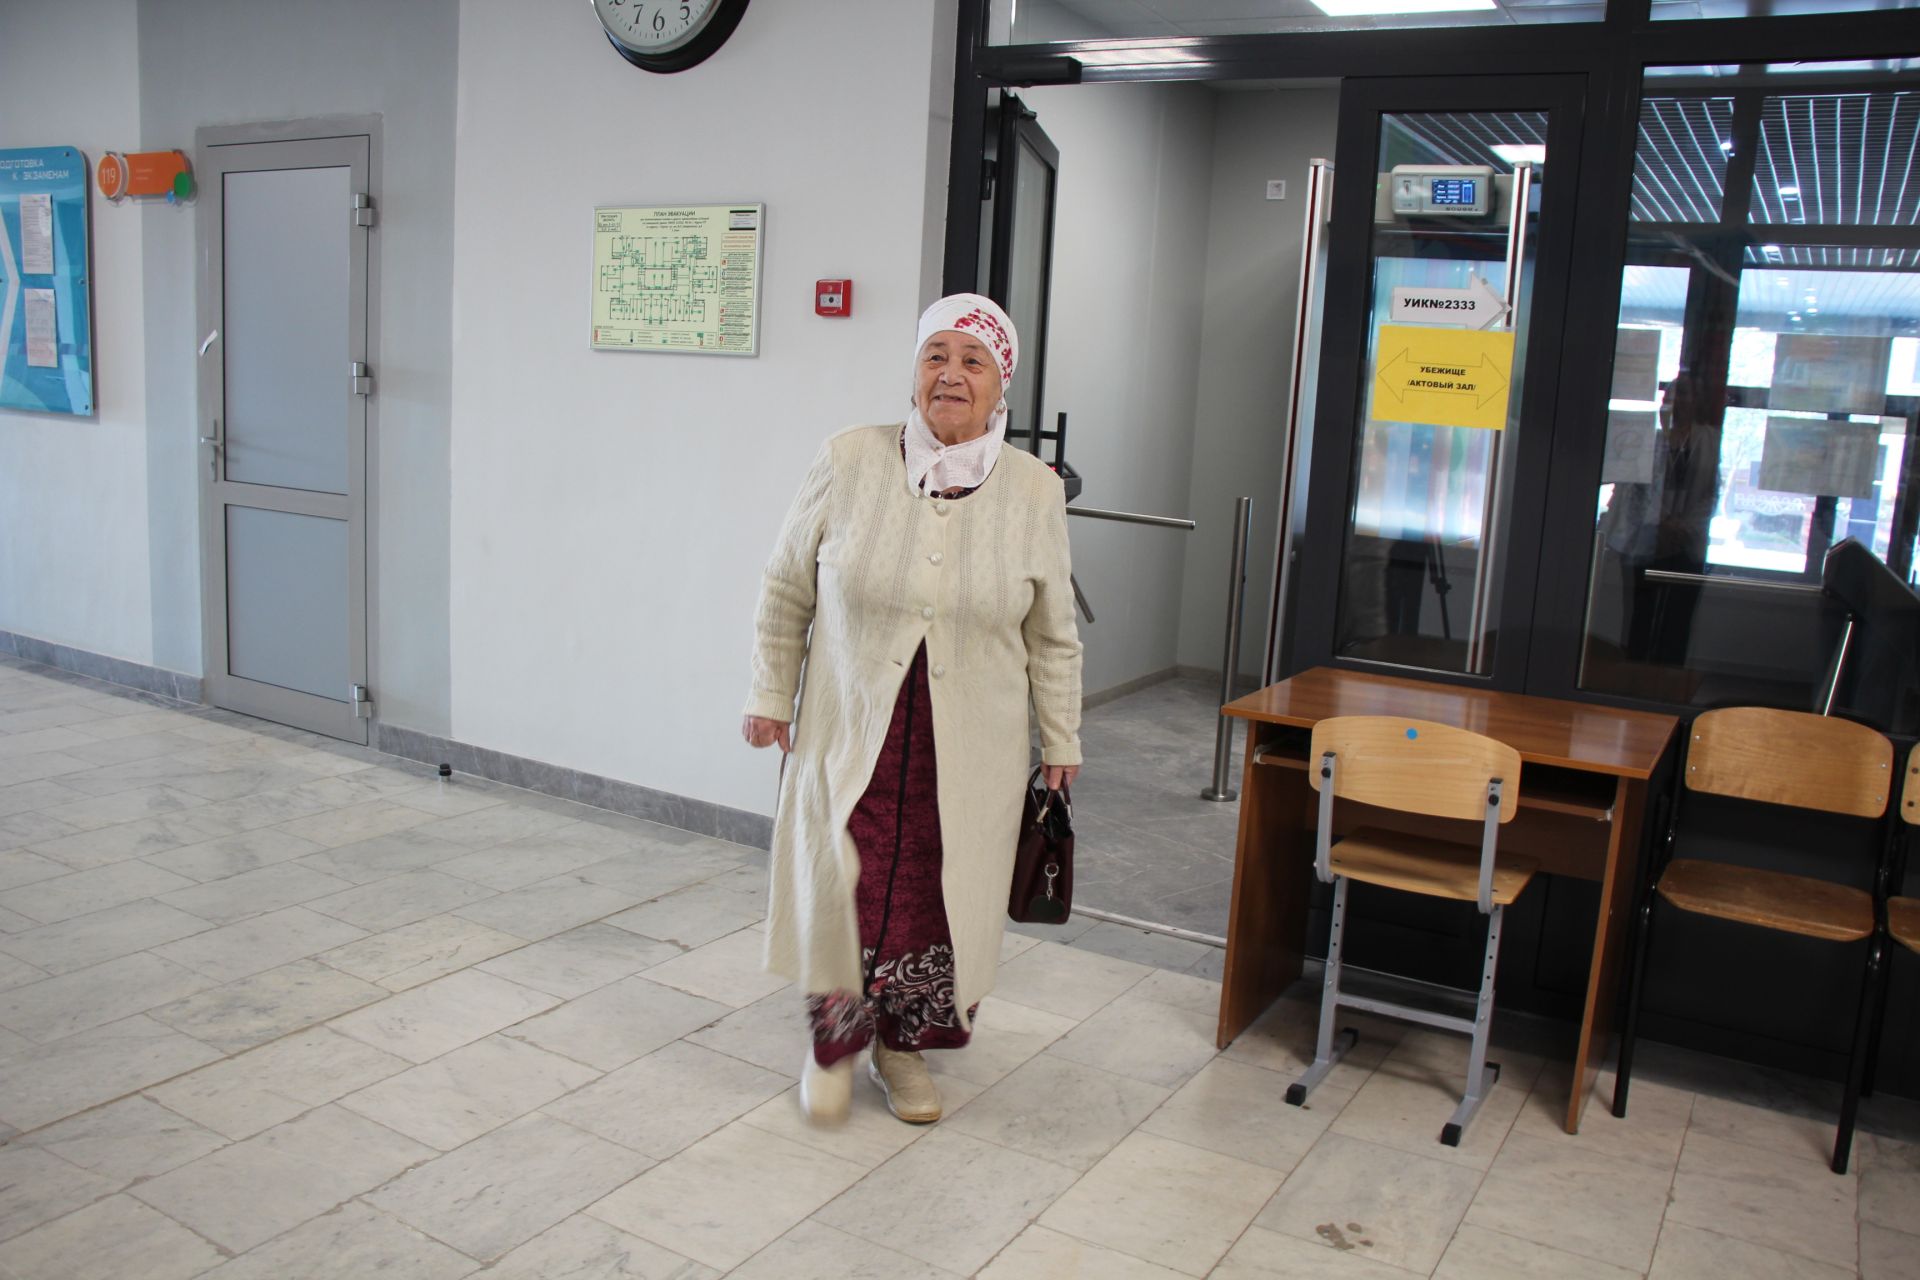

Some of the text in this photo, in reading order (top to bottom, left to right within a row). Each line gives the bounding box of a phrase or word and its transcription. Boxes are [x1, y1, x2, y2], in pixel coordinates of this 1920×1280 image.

[633, 4, 643, 25] 7
[679, 0, 691, 20] 5
[652, 7, 665, 32] 6
[0, 159, 44, 169] ОДГОТОВКА
[12, 169, 69, 181] К ЭКЗАМЕНАМ
[102, 167, 116, 185] 119
[1404, 298, 1476, 311] УИК№2333
[1420, 366, 1466, 376] УБЕЖИЩЕ
